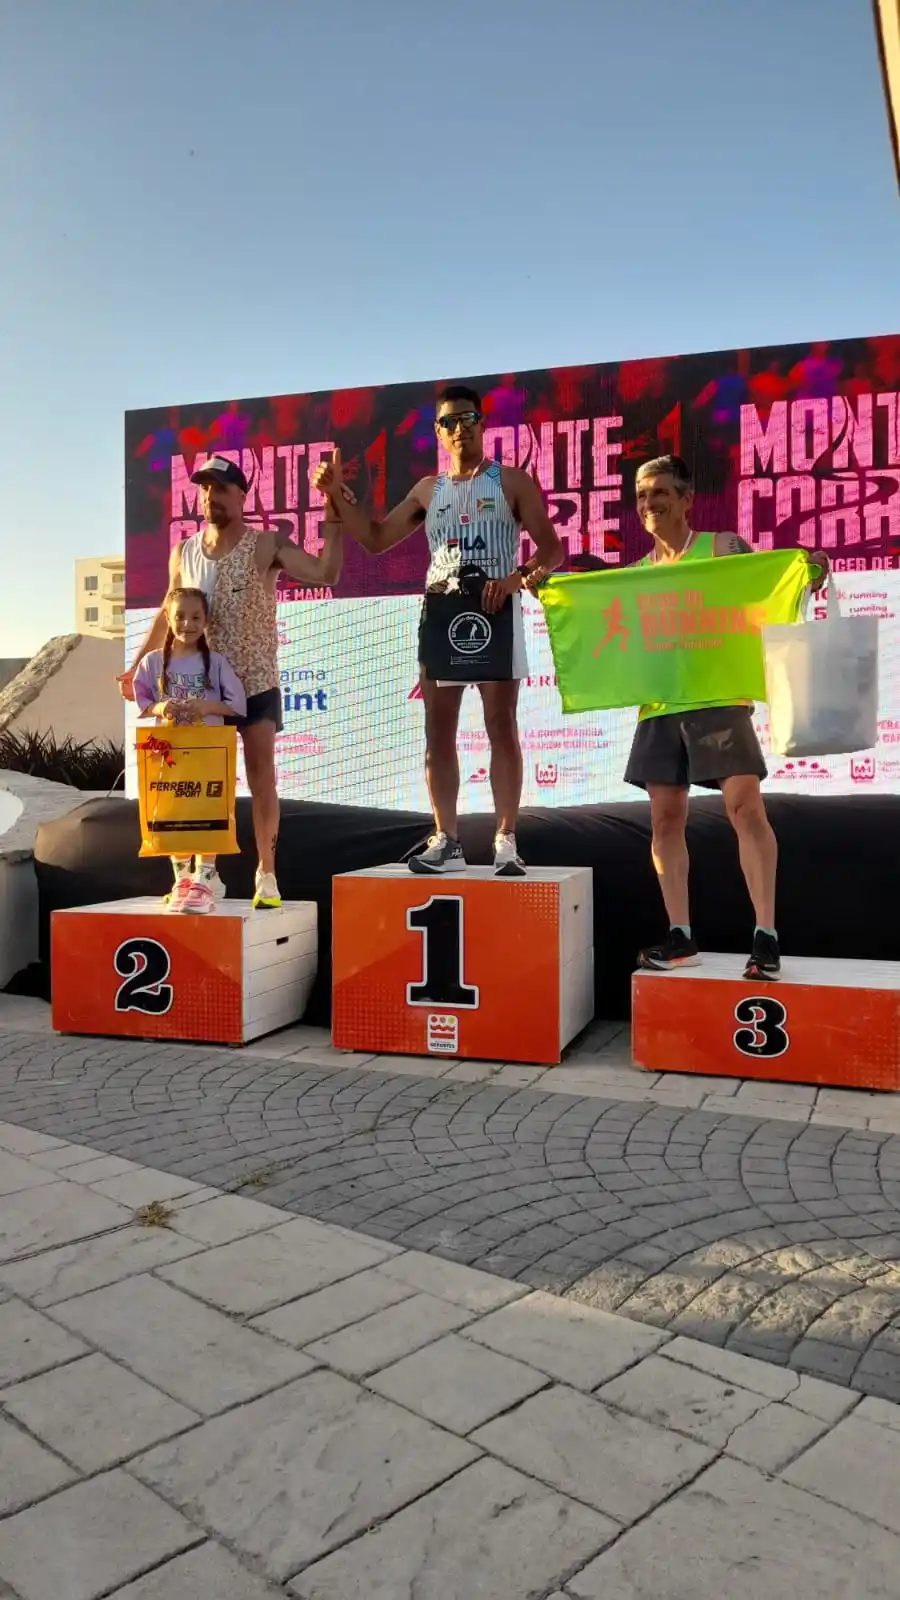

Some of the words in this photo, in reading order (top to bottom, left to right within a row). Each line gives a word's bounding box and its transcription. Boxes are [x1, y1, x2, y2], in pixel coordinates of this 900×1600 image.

[437, 416, 623, 491] ONTE
[171, 441, 336, 518] MNTE
[871, 555, 893, 571] DE
[849, 591, 888, 601] running
[849, 605, 888, 613] running
[641, 607, 766, 637] RUNNING
[150, 781, 202, 792] FERREIRA
[174, 790, 202, 798] SPORT
[407, 895, 479, 1009] 1
[114, 937, 173, 1015] 2
[733, 996, 789, 1058] 3
